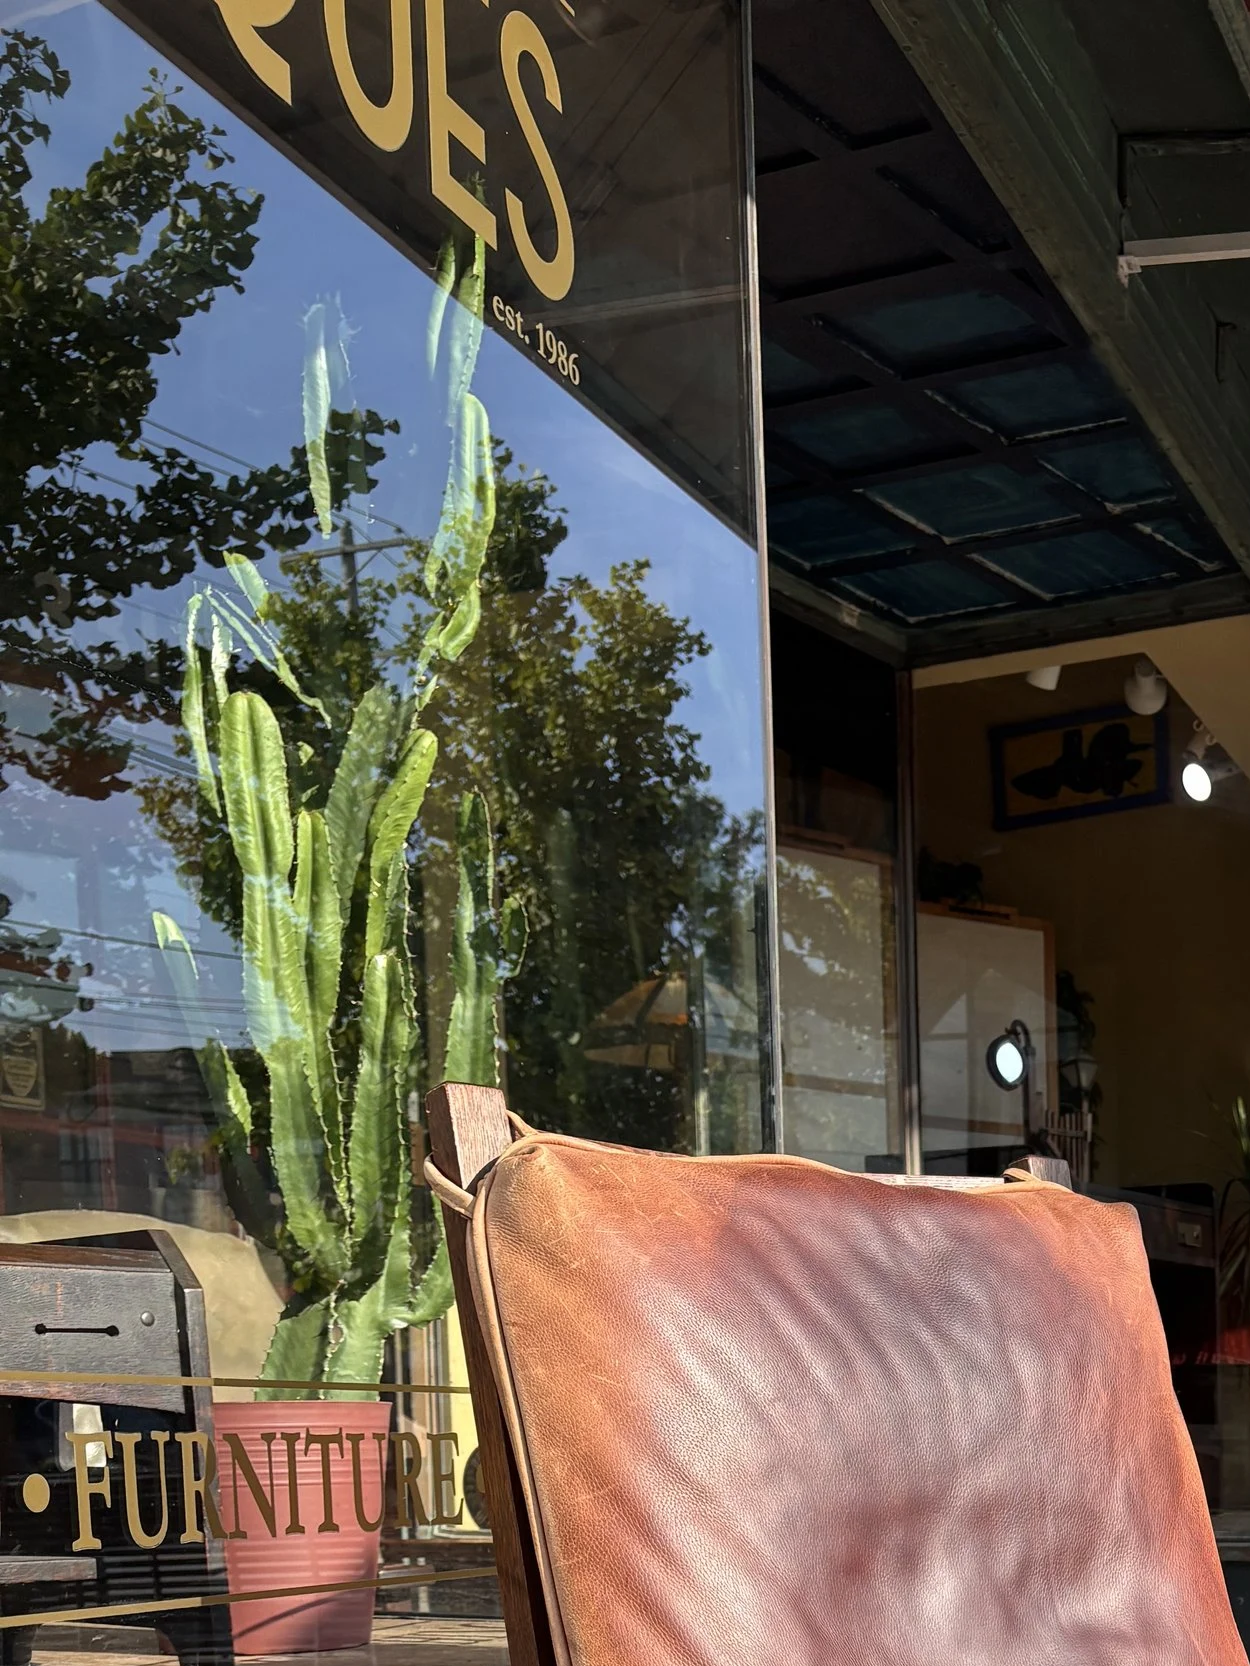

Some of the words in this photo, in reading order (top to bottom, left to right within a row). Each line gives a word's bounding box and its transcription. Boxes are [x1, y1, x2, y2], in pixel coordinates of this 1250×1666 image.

[492, 295, 530, 345] est.
[535, 322, 580, 386] 1986
[65, 1427, 464, 1553] FURNITURE
